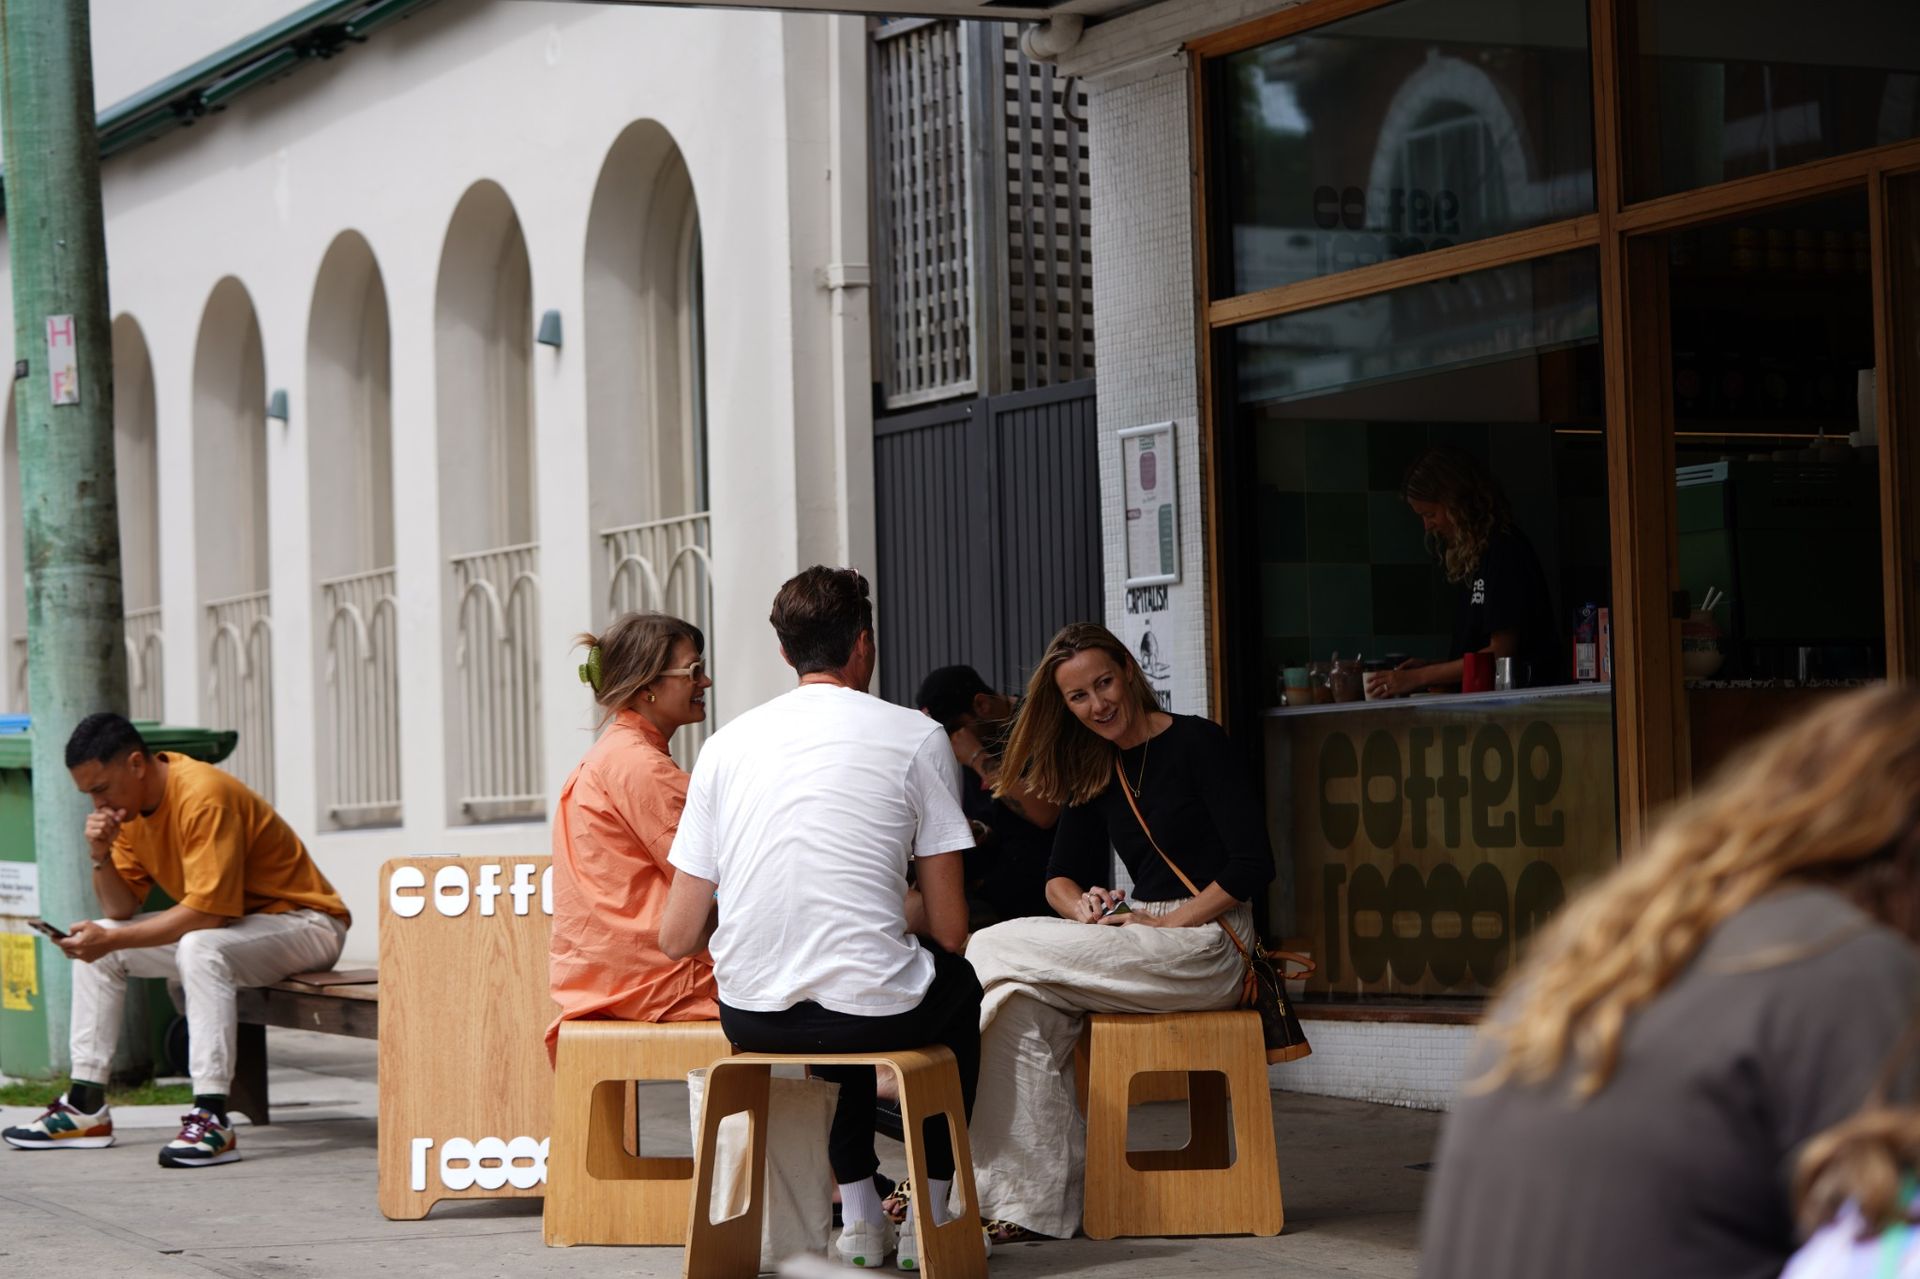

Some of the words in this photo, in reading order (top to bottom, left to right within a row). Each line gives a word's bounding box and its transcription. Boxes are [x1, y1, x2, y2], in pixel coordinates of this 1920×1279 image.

[1313, 185, 1460, 235] cofee
[48, 319, 73, 347] H
[1319, 720, 1565, 850] coffee
[411, 1136, 550, 1190] rooo
